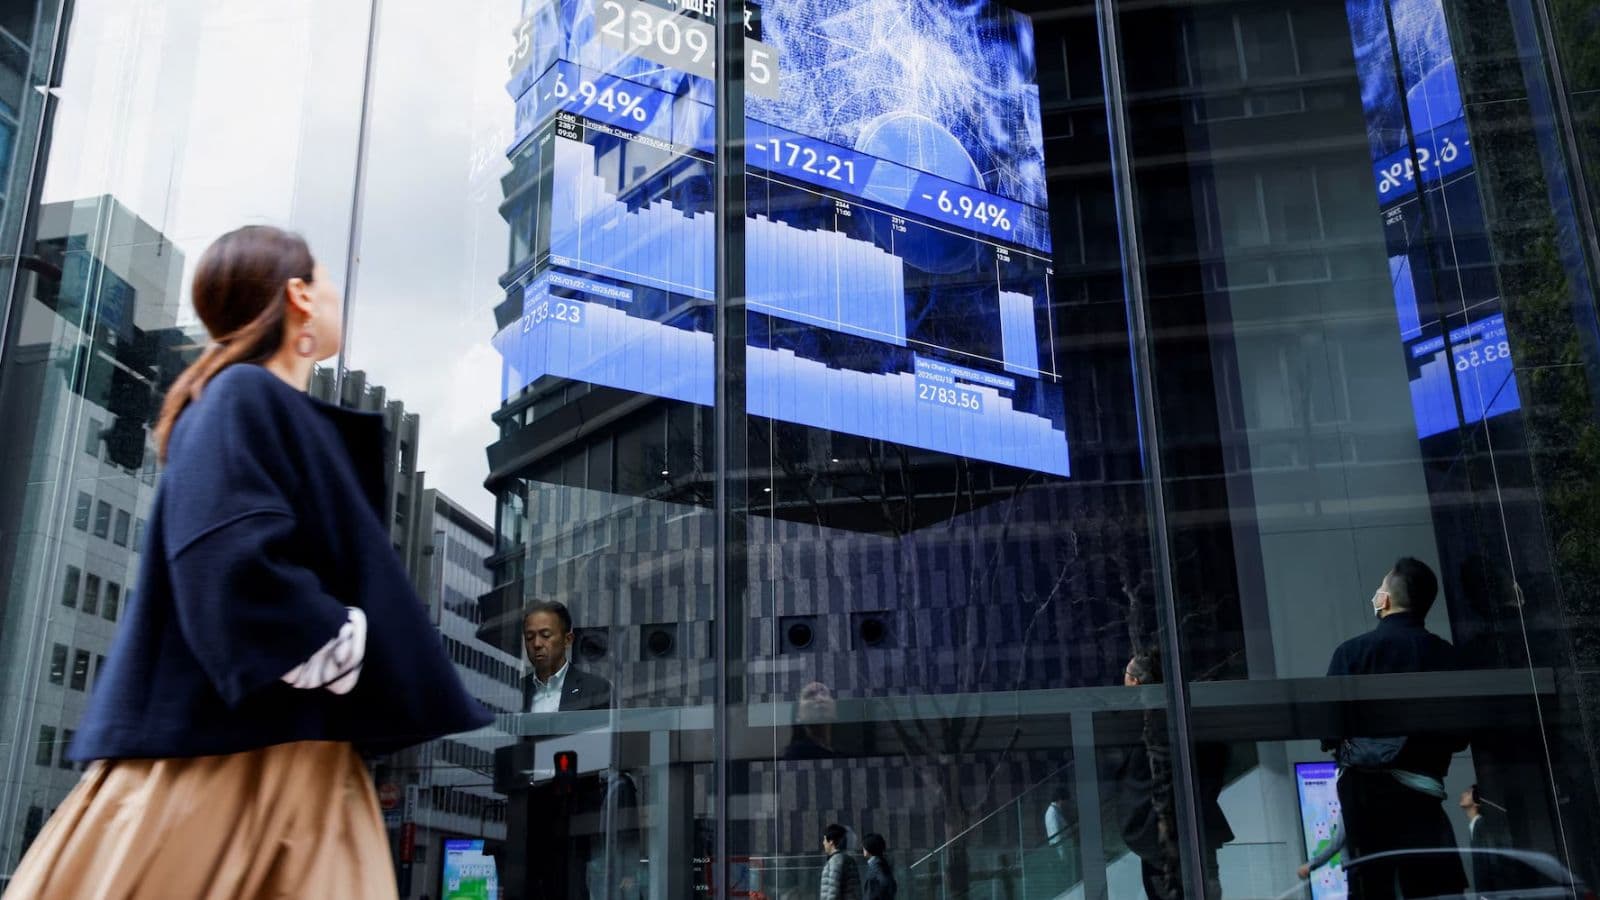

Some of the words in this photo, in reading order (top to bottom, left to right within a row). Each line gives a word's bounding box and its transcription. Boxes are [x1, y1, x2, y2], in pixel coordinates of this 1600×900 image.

[544, 72, 647, 122] -6.94%
[754, 138, 856, 185] -172.21
[919, 384, 980, 410] 2783.56
